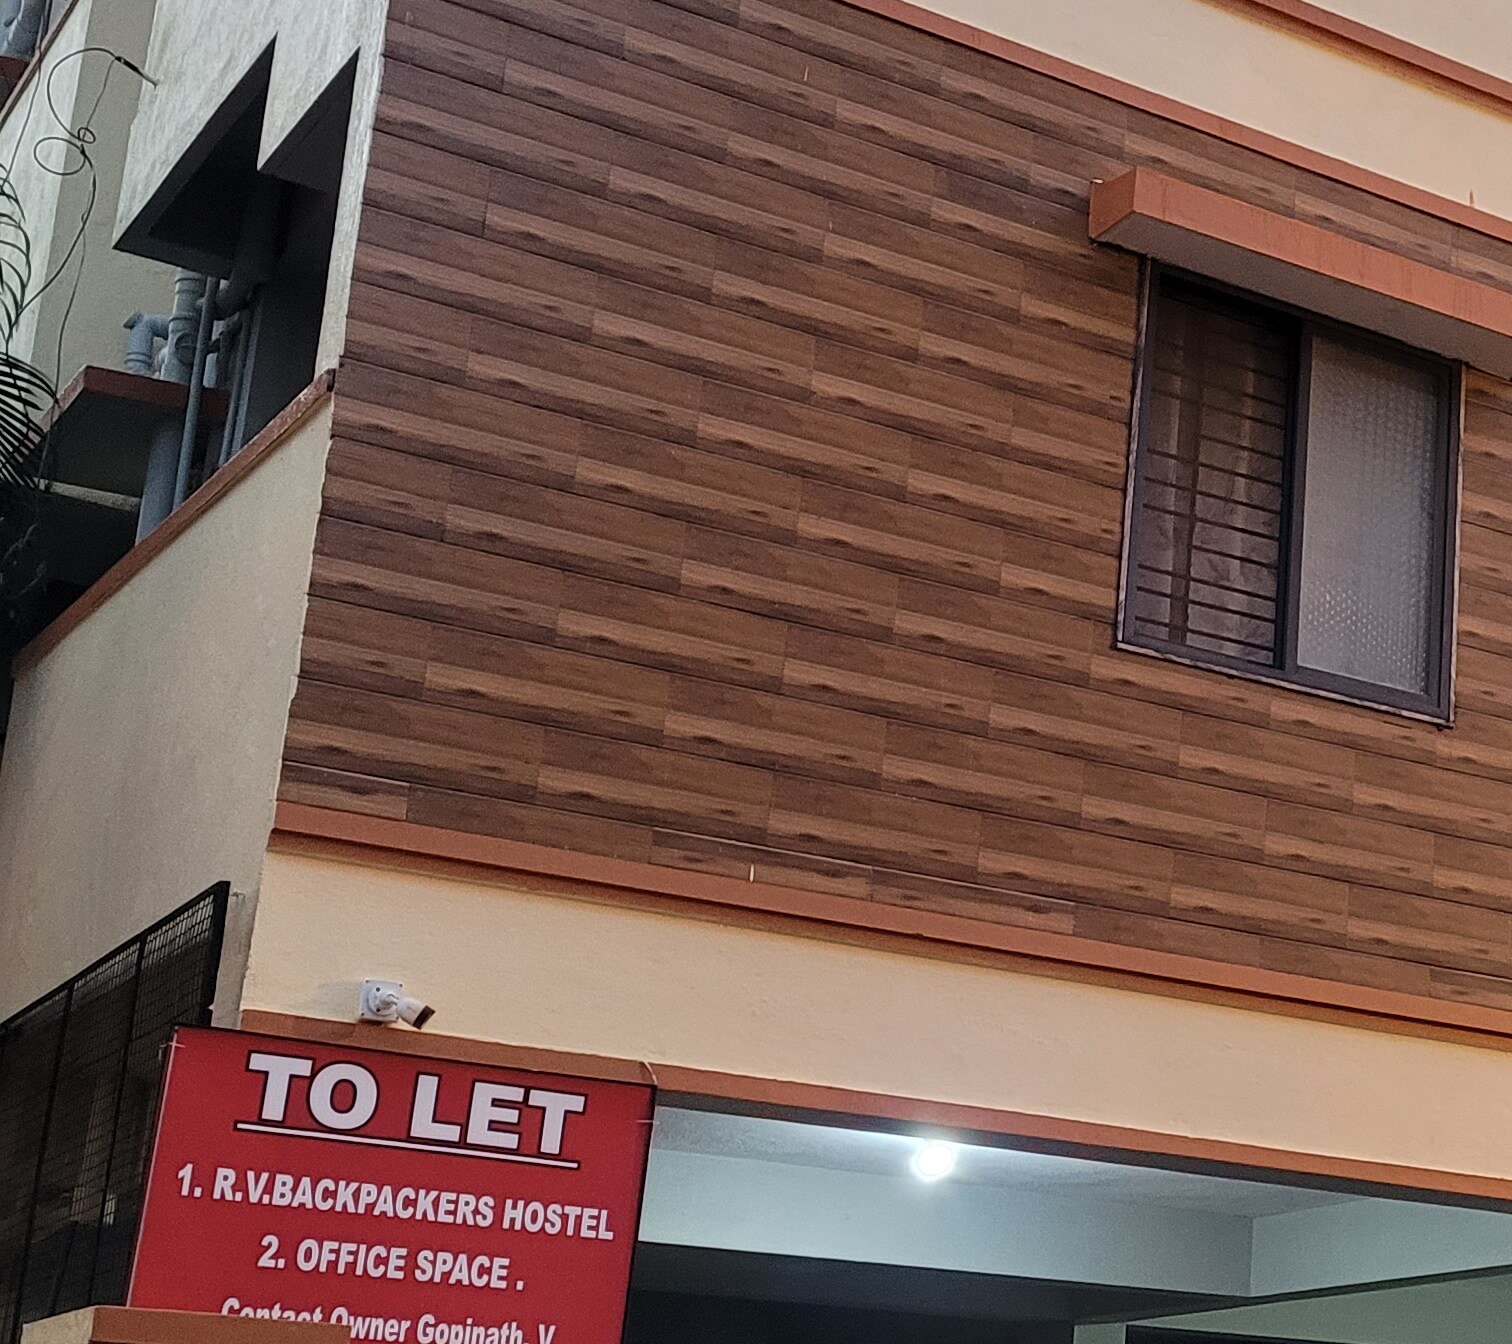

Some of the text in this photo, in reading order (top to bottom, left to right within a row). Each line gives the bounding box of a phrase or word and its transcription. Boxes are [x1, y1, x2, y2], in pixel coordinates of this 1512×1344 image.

[248, 1052, 587, 1156] TO LET
[176, 1163, 615, 1241] 1. R.V.BACKPACKERS HOSTEL
[256, 1235, 286, 1269] 2.
[296, 1238, 408, 1280] OFFICE
